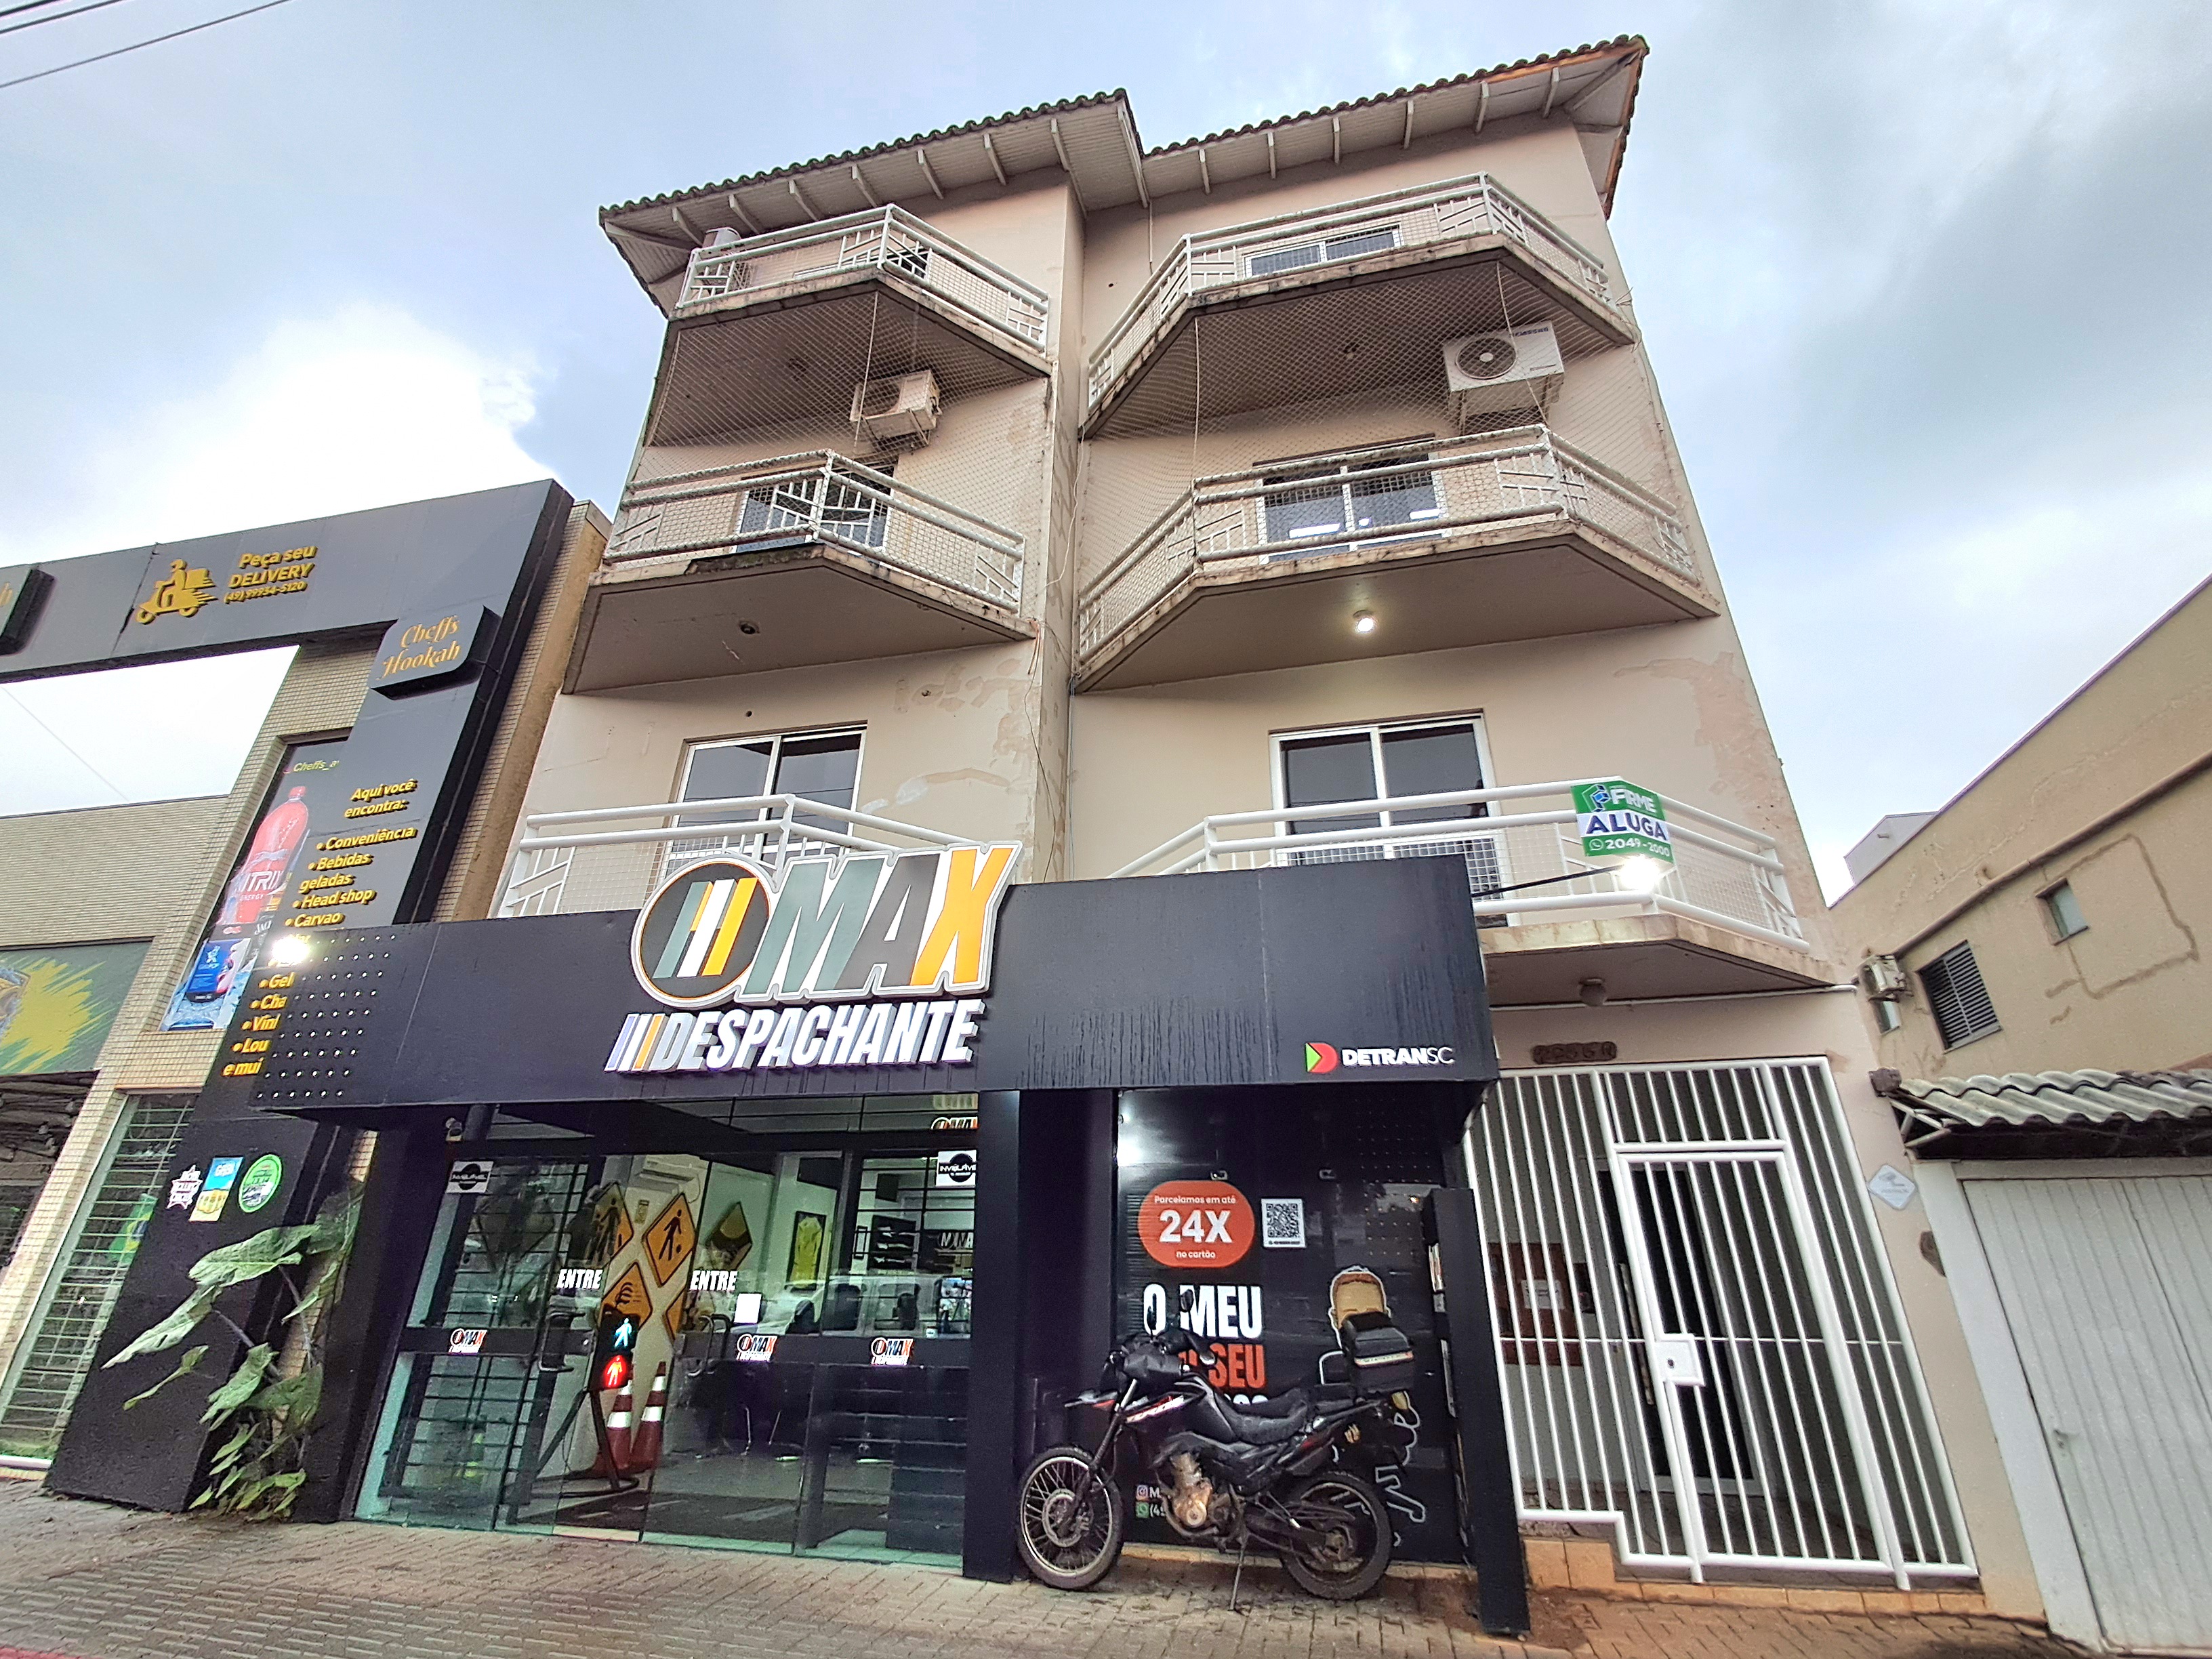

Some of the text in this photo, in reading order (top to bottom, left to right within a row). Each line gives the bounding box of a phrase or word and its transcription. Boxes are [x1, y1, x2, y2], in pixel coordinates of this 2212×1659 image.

[239, 546, 318, 569] Peça seu
[228, 562, 315, 588] DELIVERY
[375, 640, 462, 680] Hookah
[350, 778, 418, 802] Aqui você
[325, 826, 418, 850] Conveniência
[1586, 813, 1667, 841] ALUGA
[316, 853, 373, 871] Bebidas
[298, 873, 355, 894] geladas
[300, 888, 377, 909] Head shop
[631, 840, 1023, 1008] OMAX
[651, 998, 985, 1071] DESPACHANTE
[222, 1063, 235, 1077] e
[1155, 1195, 1205, 1204] Parcelamos
[1221, 1195, 1236, 1204] até
[1159, 1210, 1233, 1244] 24X
[1188, 1250, 1216, 1259] cartão
[556, 1269, 604, 1289] ENTRE
[690, 1270, 738, 1290] ENTRE
[1143, 1284, 1263, 1338] O MEU
[1208, 1343, 1267, 1389] SEU
